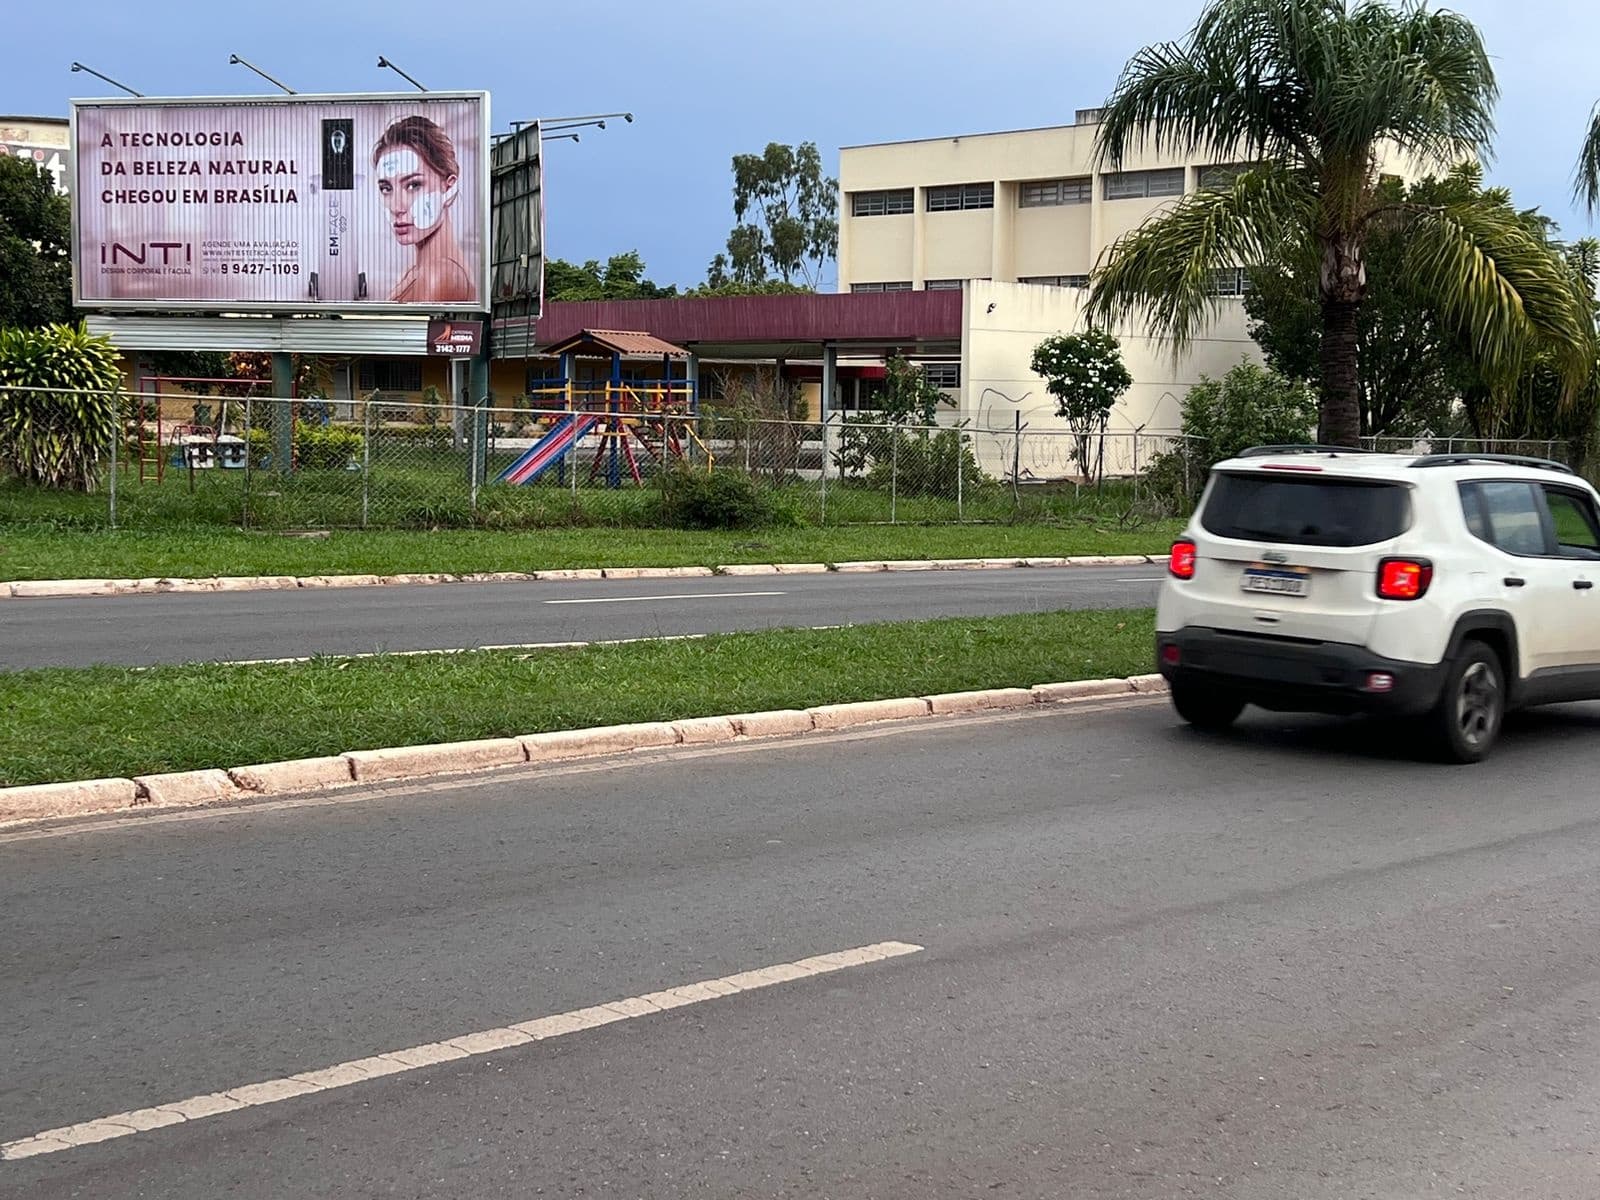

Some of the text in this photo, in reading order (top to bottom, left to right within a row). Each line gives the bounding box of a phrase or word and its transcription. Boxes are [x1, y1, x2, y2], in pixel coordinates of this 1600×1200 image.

[101, 131, 244, 147] A TECNOLOGIA
[101, 160, 298, 175] DA BELEZA NATURAL
[101, 184, 298, 204] CHEGOU EM BRASÍLIA
[329, 199, 339, 256] EMFACE
[221, 263, 228, 275] 9
[232, 263, 300, 275] 9427-1109
